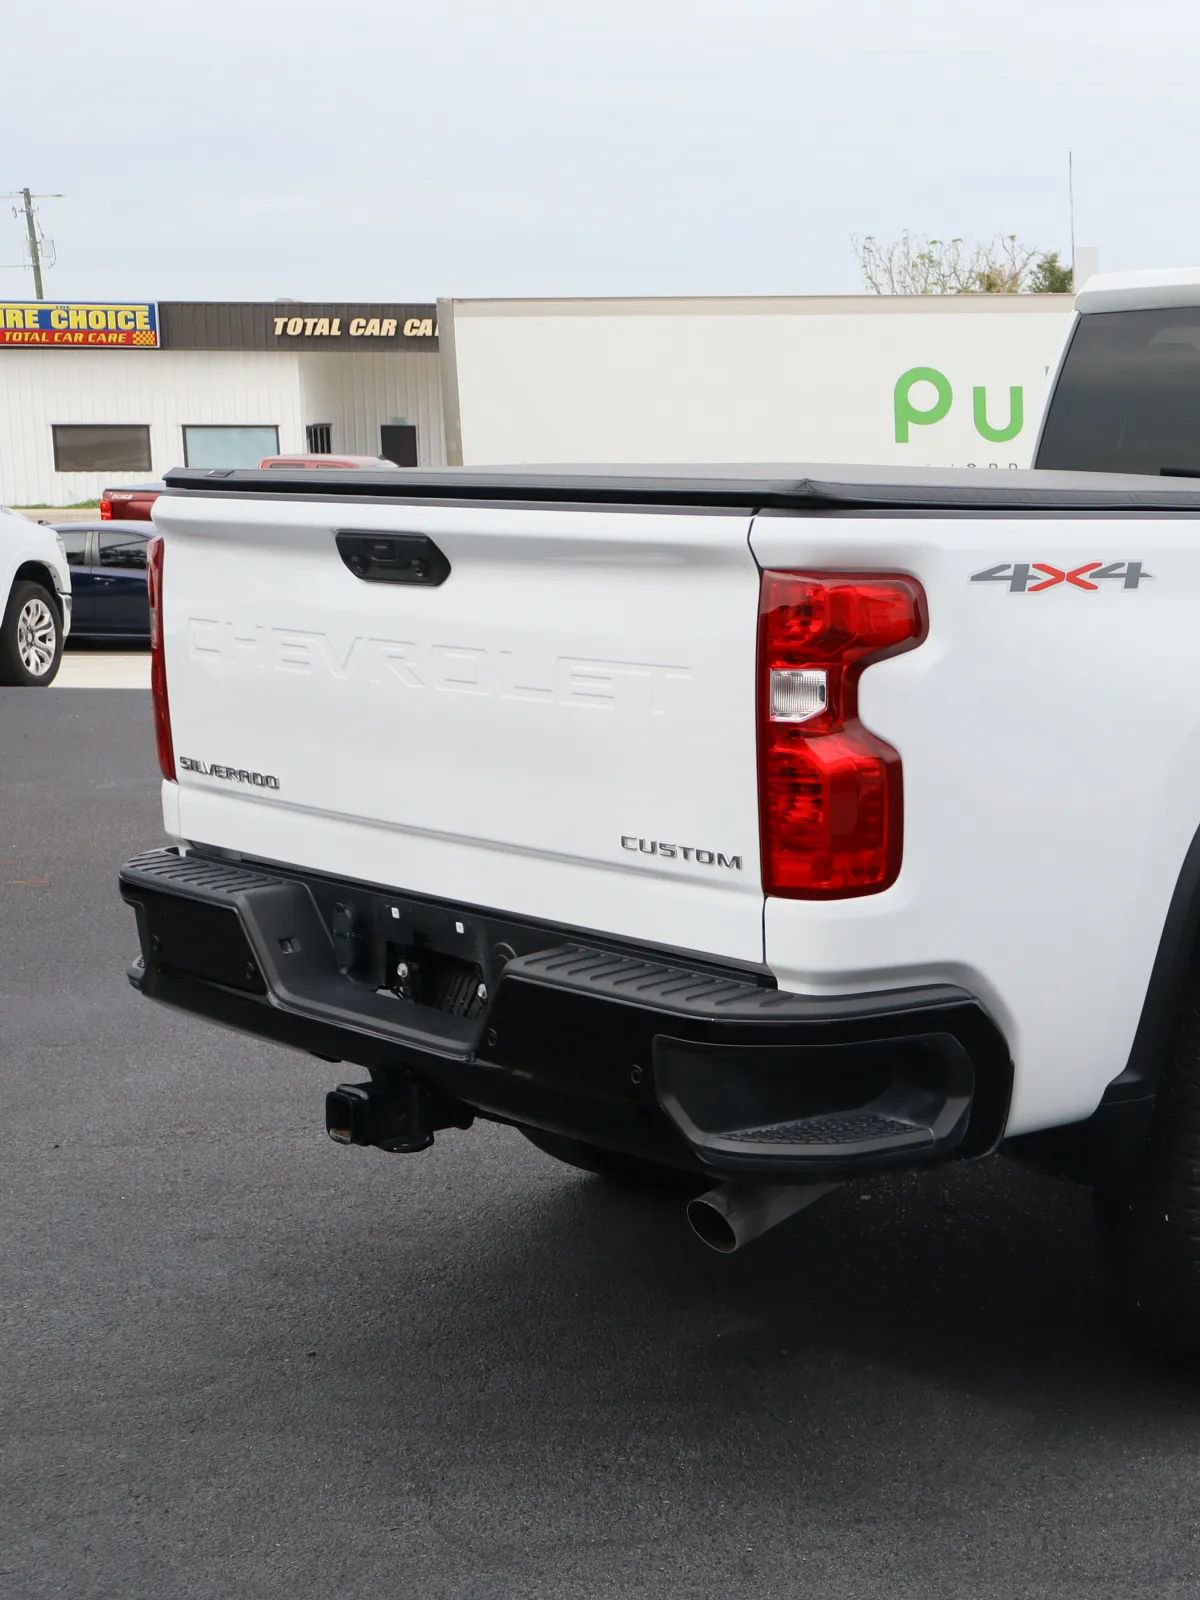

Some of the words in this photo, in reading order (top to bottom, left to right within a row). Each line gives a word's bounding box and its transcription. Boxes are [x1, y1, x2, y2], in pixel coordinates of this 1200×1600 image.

[50, 309, 151, 330] CHOICE
[274, 317, 341, 336] TOTAL
[349, 318, 397, 336] CAR
[403, 318, 439, 336] CA
[4, 331, 49, 342] TOTAL
[54, 332, 83, 342] CAR
[88, 333, 126, 343] CARE
[894, 366, 1050, 443] Pu
[187, 617, 693, 715] CHEVROLET
[179, 756, 280, 790] SILVERADO
[620, 835, 743, 870] CUSTOM
